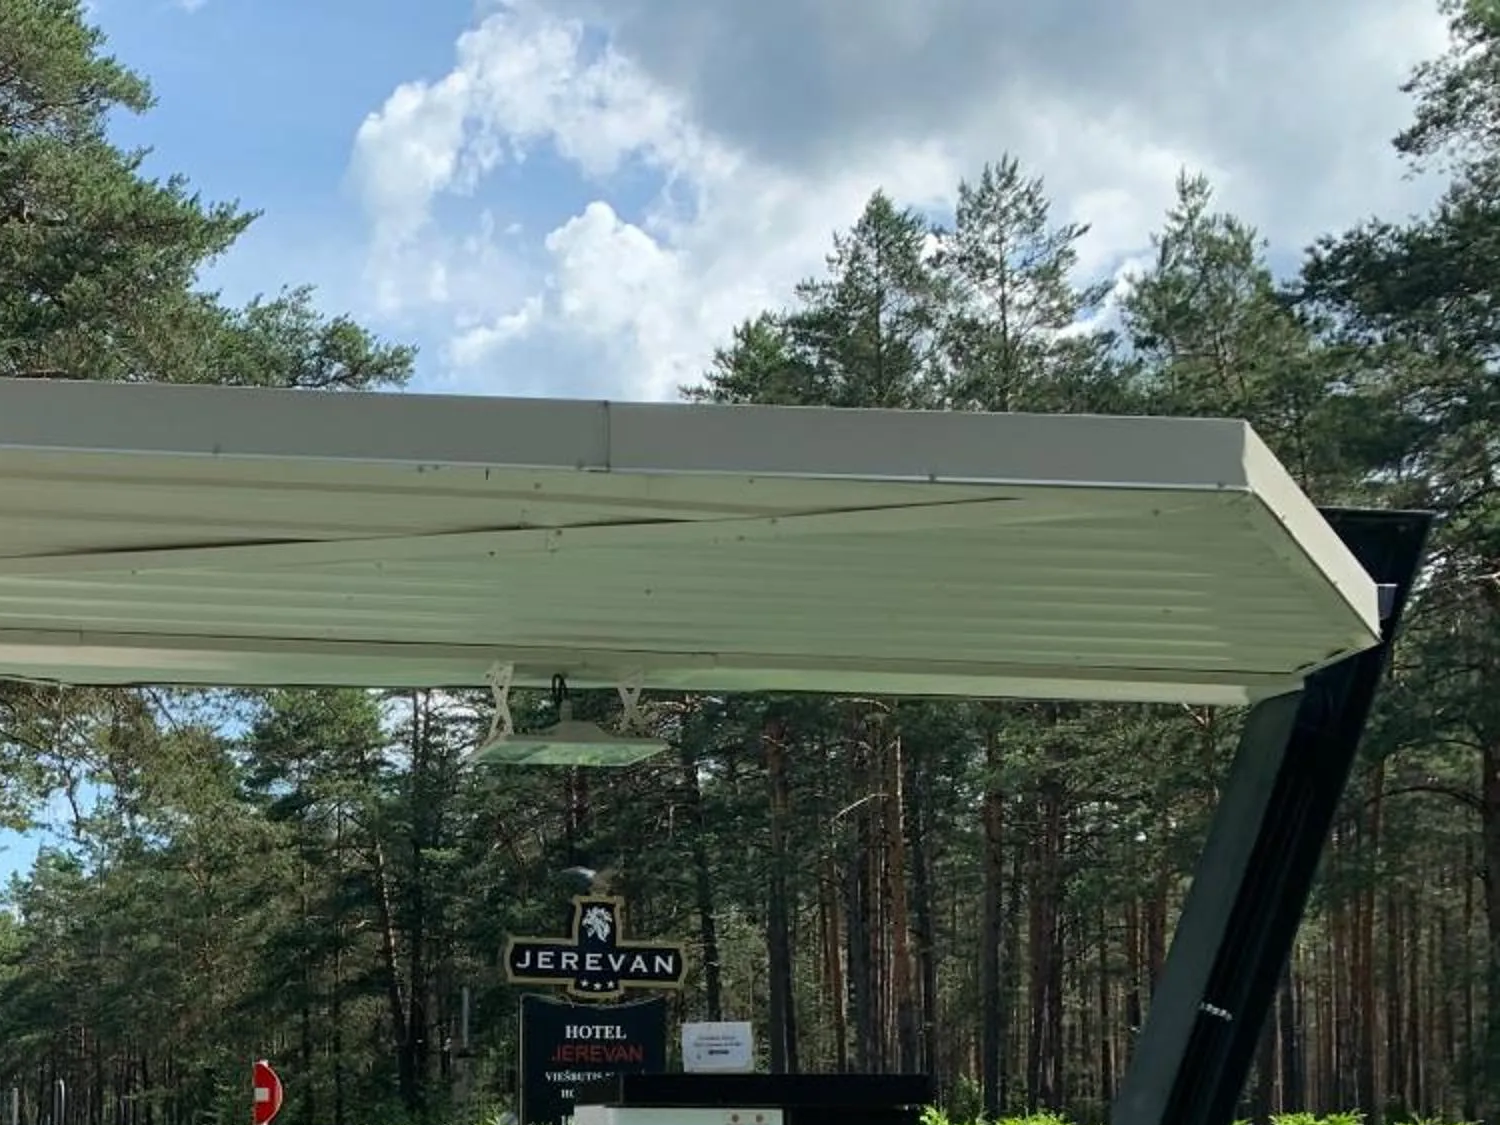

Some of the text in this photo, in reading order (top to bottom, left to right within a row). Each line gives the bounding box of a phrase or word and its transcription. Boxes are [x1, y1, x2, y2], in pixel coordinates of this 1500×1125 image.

[515, 950, 674, 974] JEREVAN
[565, 1024, 627, 1039] HOTEL
[550, 1045, 644, 1062] JEREVAN
